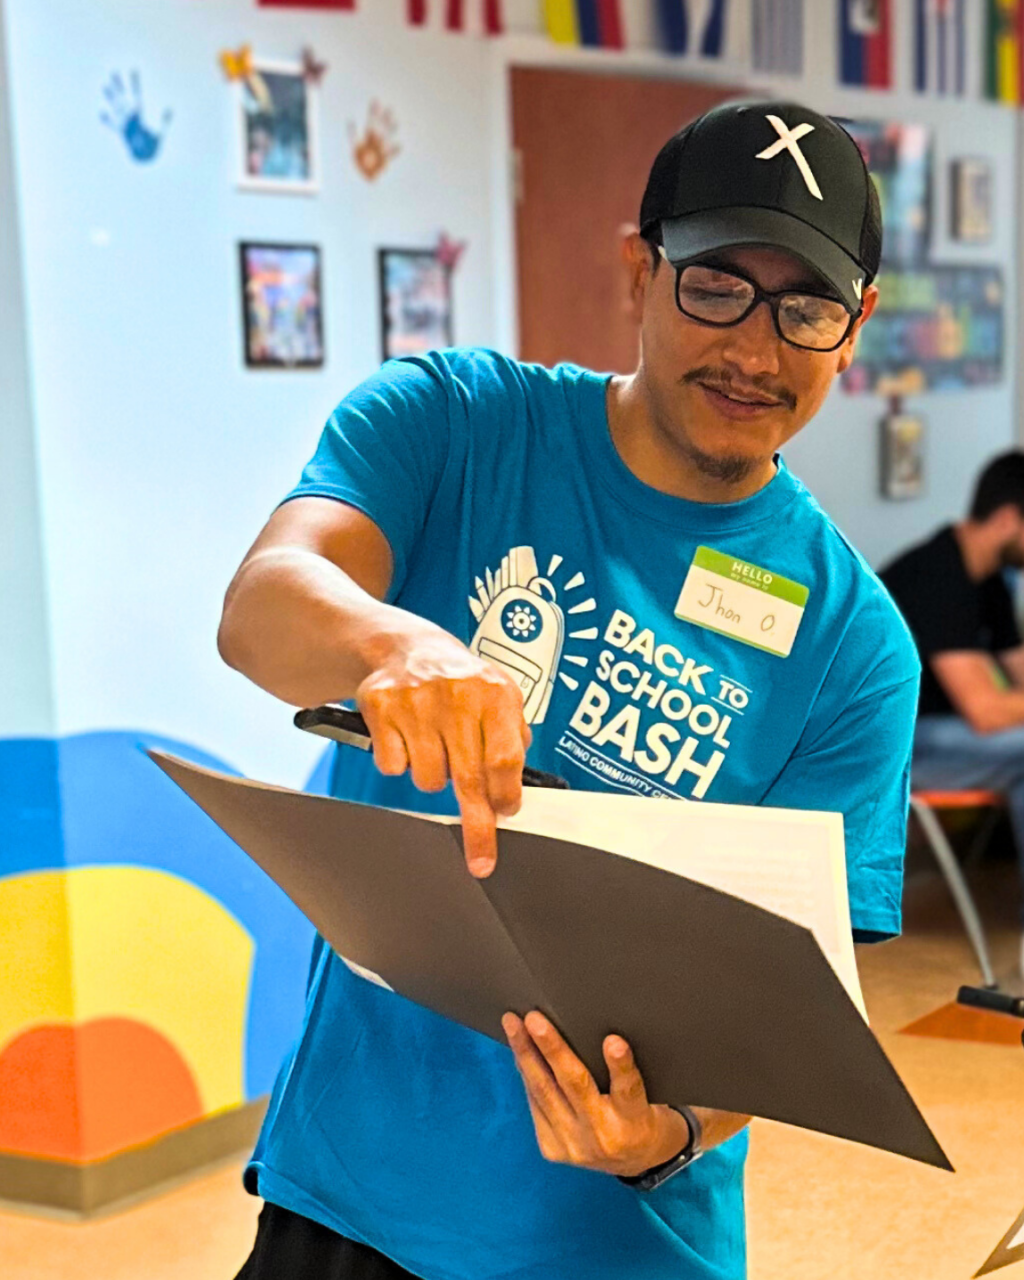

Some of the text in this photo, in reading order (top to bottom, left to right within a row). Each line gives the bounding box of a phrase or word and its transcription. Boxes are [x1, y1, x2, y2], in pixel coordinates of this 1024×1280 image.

[697, 582, 742, 625] Jhon
[731, 561, 773, 585] HELLO
[595, 649, 731, 749] SCHOOL
[603, 608, 749, 711] BACK TO
[558, 735, 591, 763] LATINO
[588, 756, 653, 794] COMMUNITY
[568, 680, 726, 800] BASH
